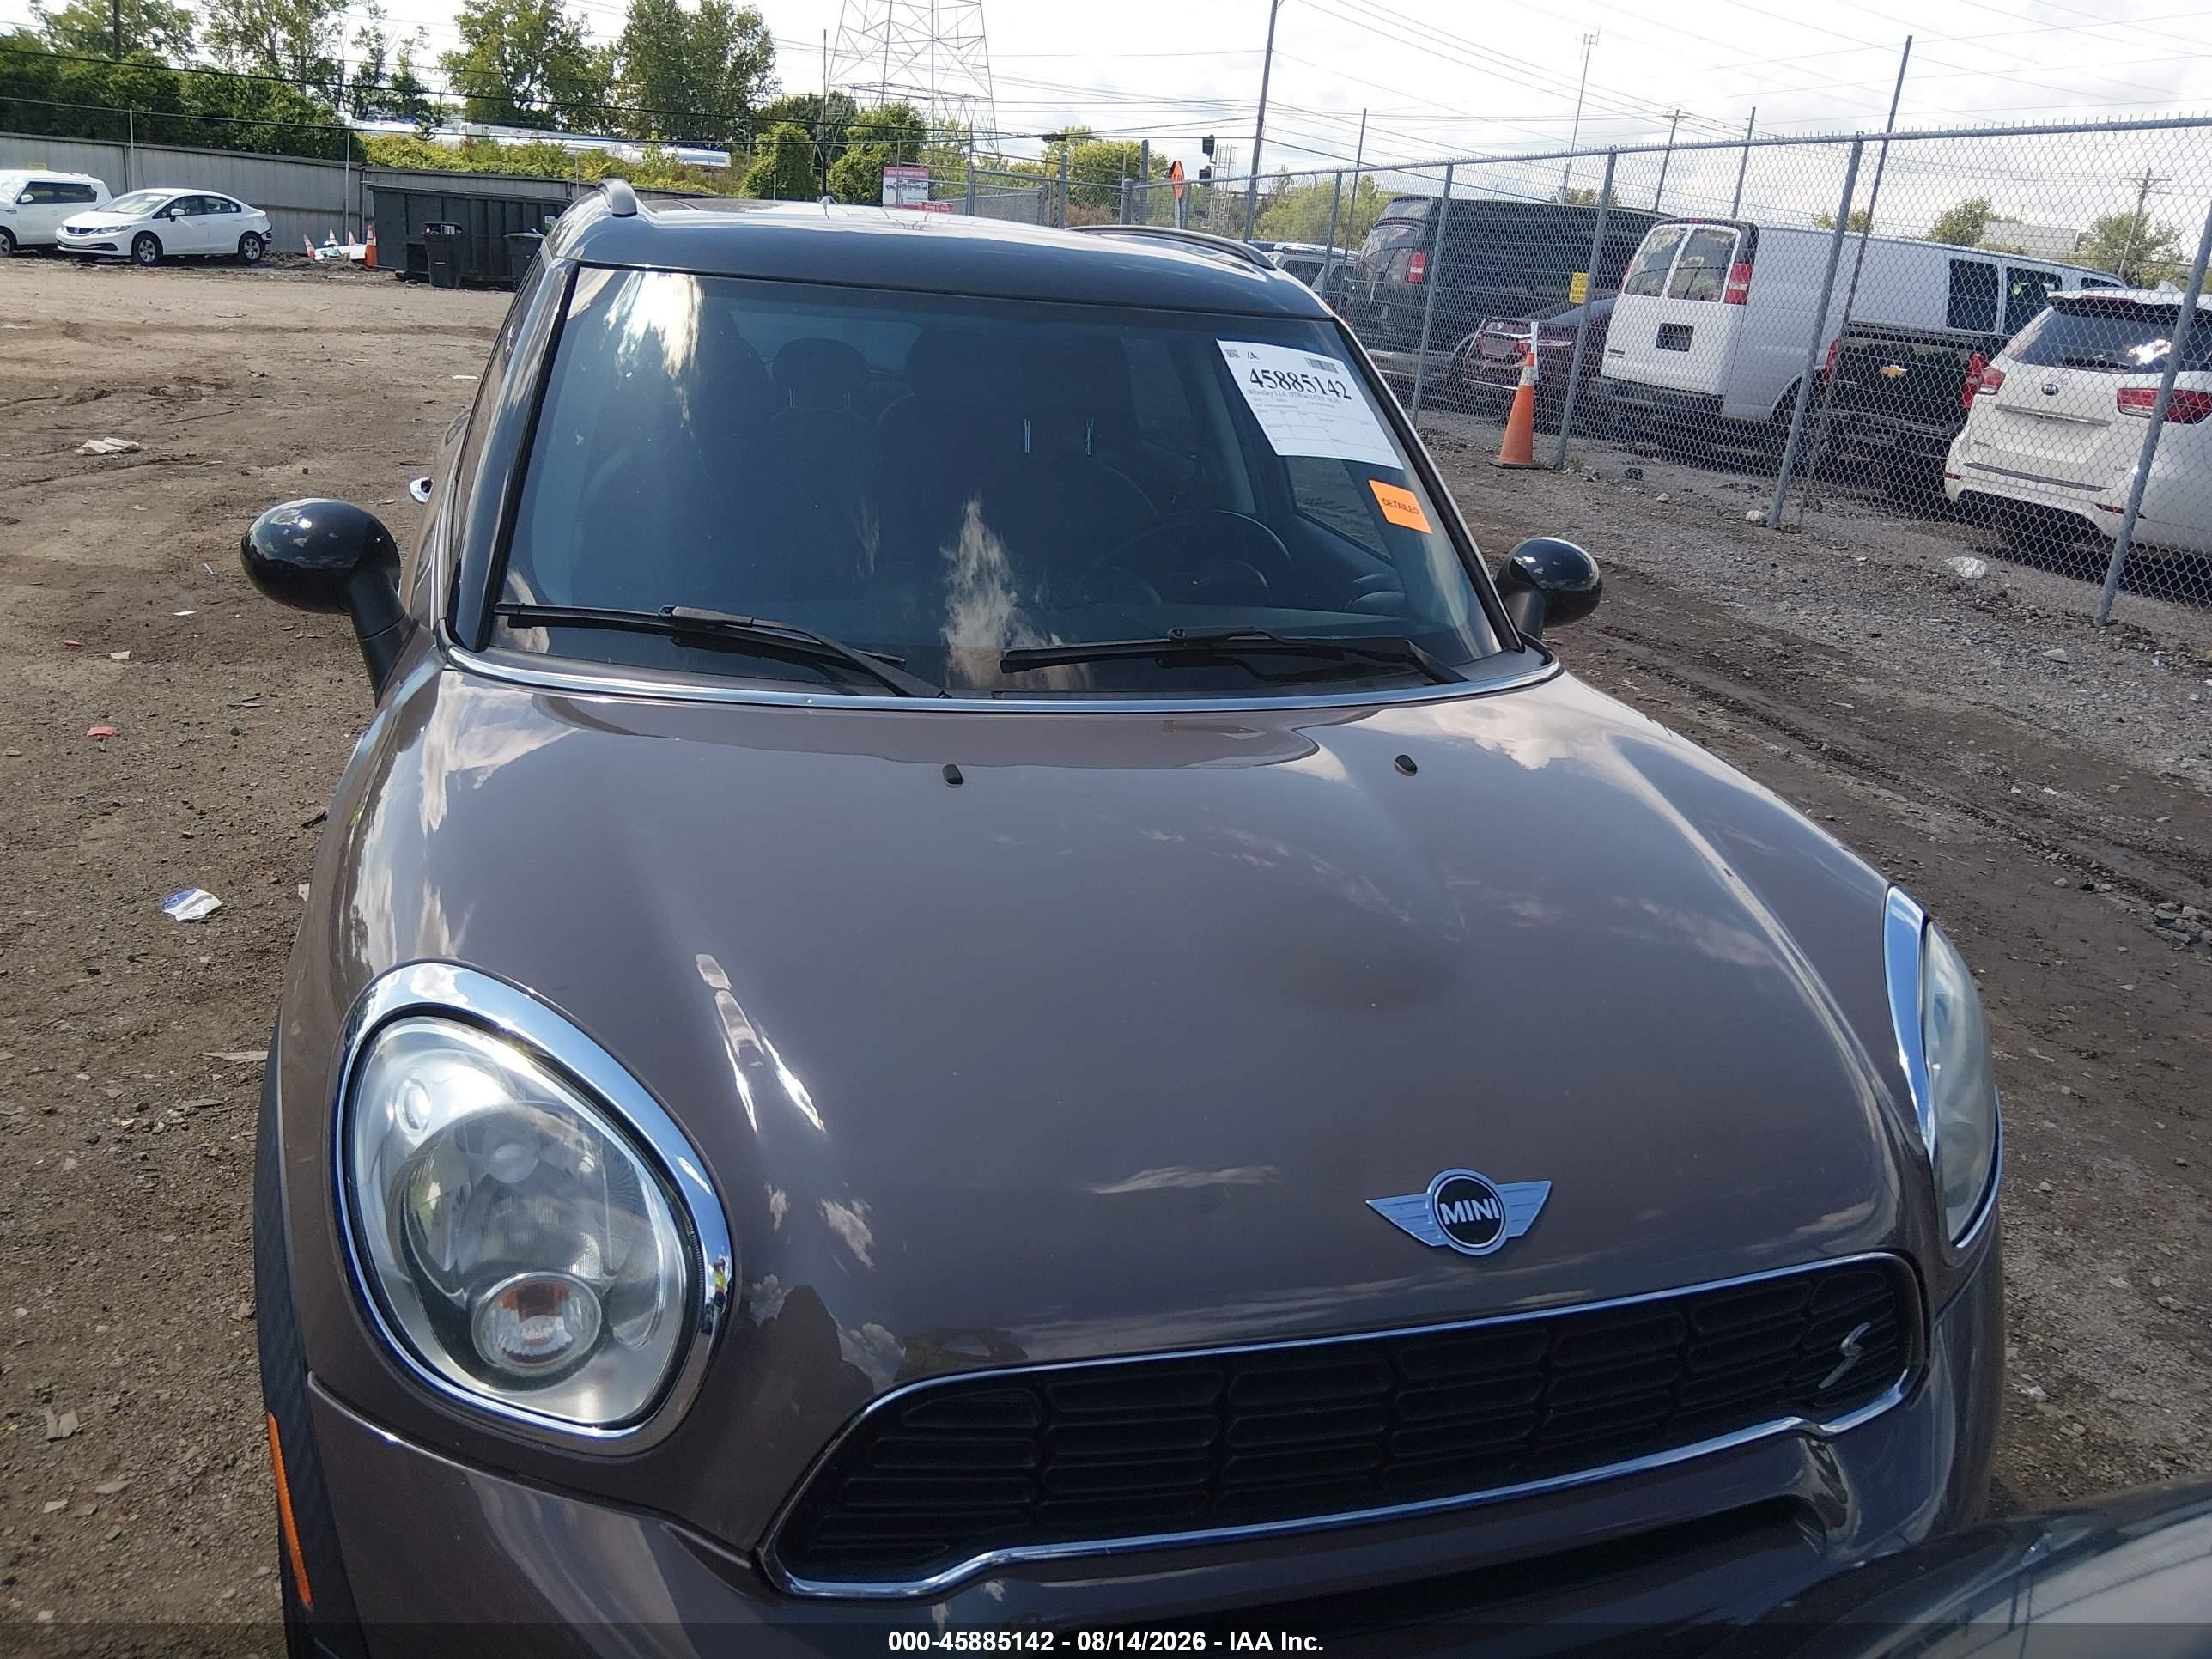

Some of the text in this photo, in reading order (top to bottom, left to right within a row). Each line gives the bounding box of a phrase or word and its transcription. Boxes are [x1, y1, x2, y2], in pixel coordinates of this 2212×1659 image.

[1249, 368, 1352, 400] 45885142
[1382, 497, 1419, 514] DETAILED
[1439, 1197, 1501, 1225] MINI
[1818, 1322, 1871, 1389] S
